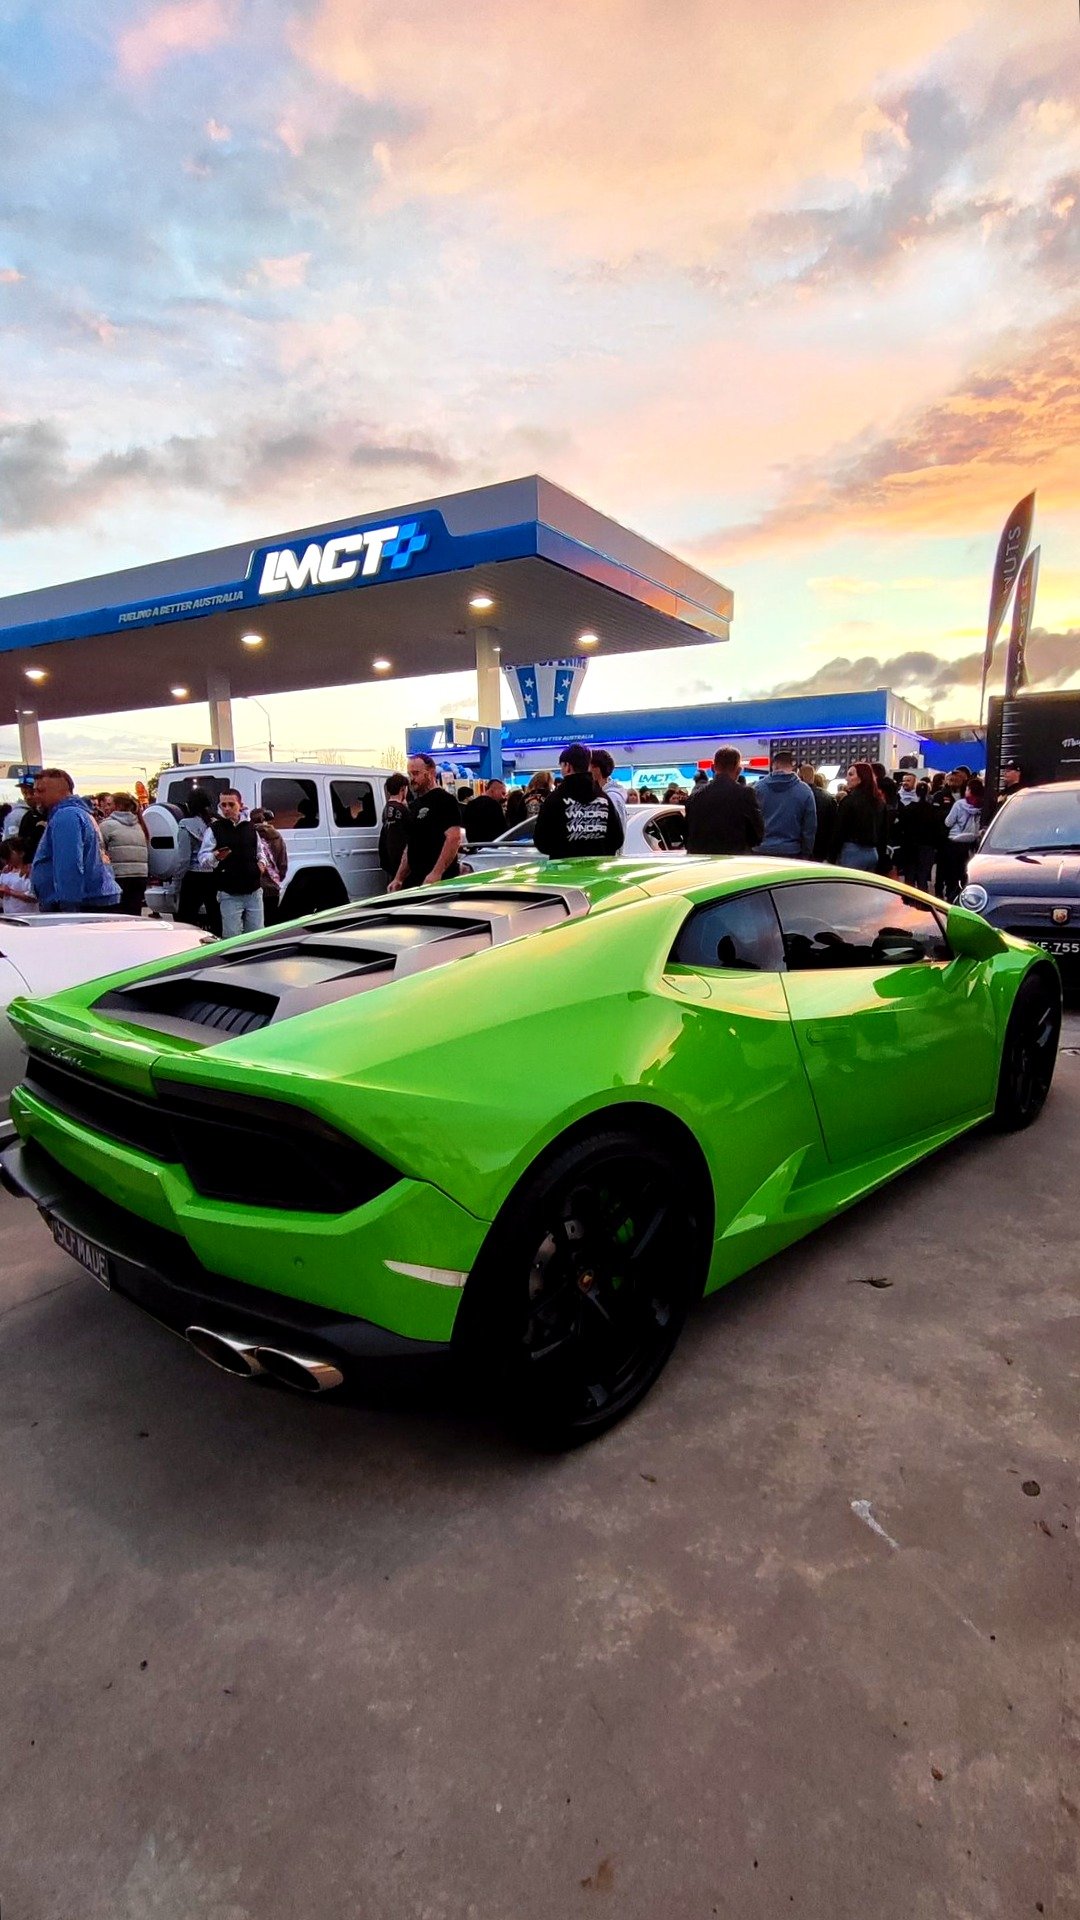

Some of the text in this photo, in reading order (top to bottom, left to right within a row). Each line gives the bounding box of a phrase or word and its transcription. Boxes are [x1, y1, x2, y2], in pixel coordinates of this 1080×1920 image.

[118, 590, 244, 623] FUELING A BETTER AUSTRALIA
[480, 731, 485, 743] 1
[209, 752, 215, 762] 3
